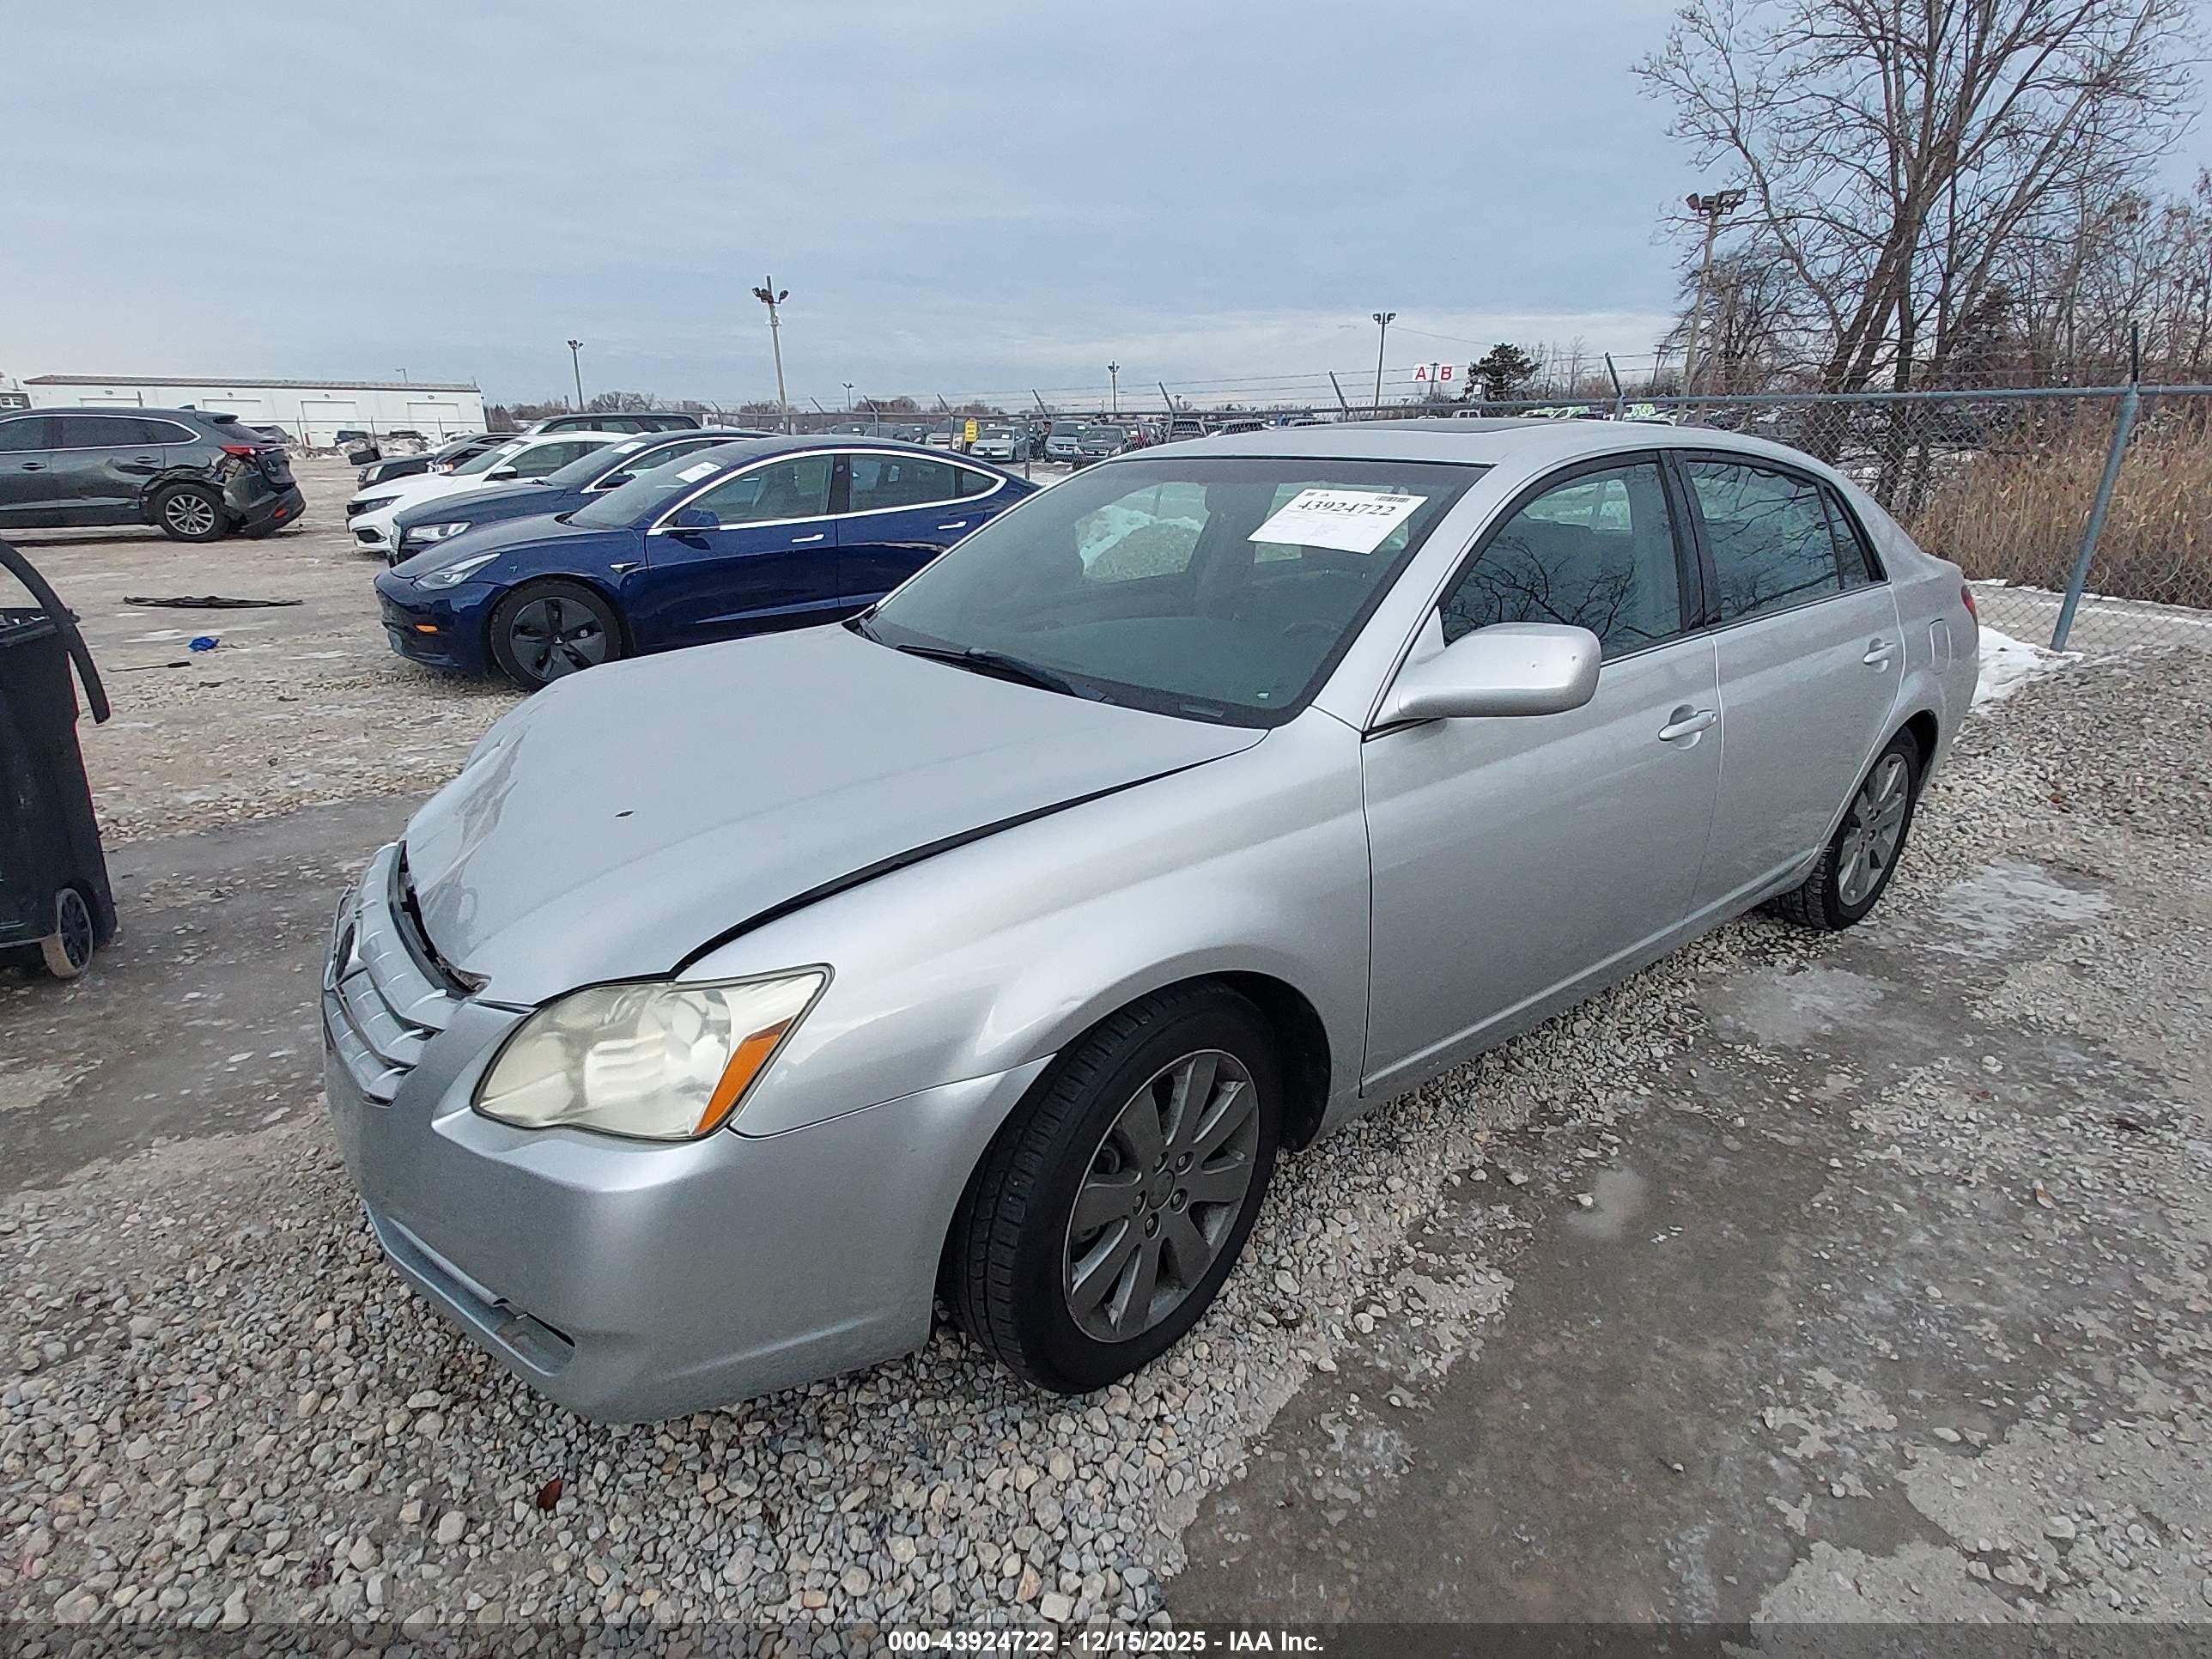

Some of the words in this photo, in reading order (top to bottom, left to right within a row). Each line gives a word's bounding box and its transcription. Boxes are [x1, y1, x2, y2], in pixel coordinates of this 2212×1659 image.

[1415, 366, 1426, 380] A
[1441, 366, 1453, 380] B
[1298, 500, 1397, 515] 43924722
